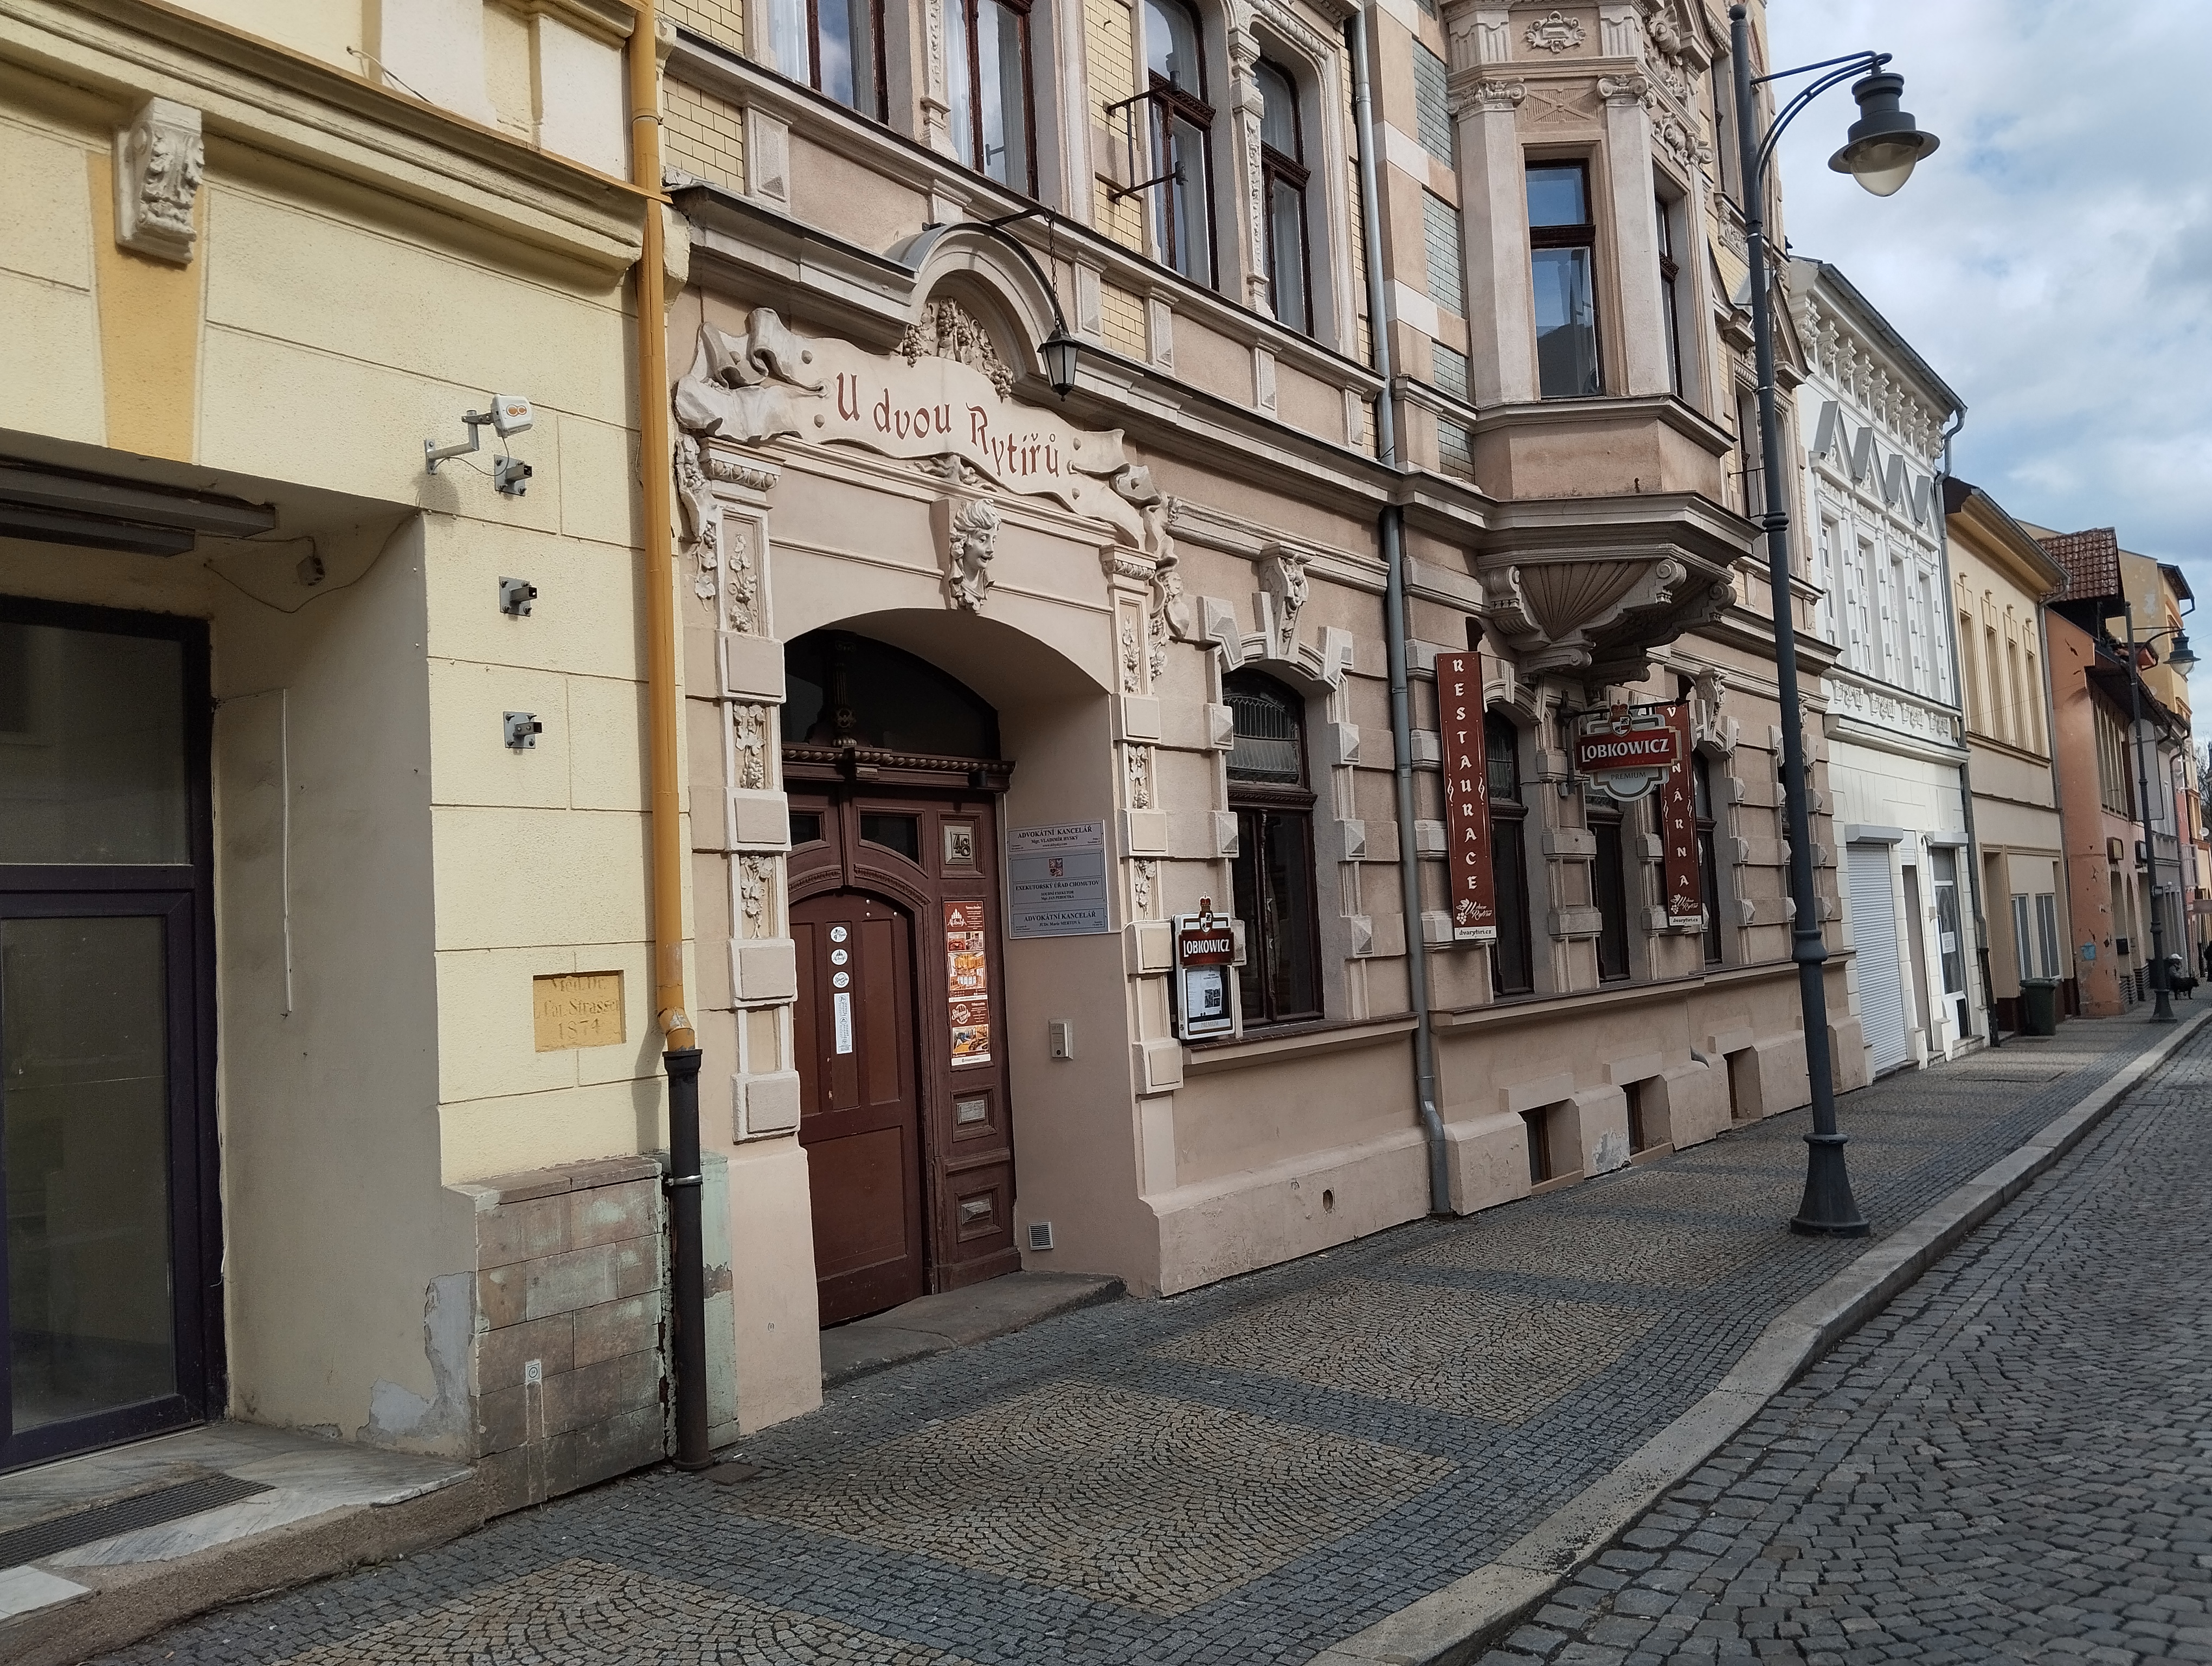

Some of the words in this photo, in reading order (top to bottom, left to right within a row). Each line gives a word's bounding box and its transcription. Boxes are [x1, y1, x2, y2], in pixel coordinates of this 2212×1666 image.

[837, 372, 860, 421] U
[873, 388, 952, 440] dvou
[965, 401, 1060, 478] Rytířů
[1581, 738, 1670, 763] LOBKOWICZ
[1452, 658, 1478, 890] RESTAURACE
[1611, 772, 1646, 780] PREMIUM
[1666, 706, 1689, 887] VNÁRNA
[1018, 828, 1054, 838] ADVOKÁTNÍ
[1057, 825, 1092, 835] KANCELÁŘ
[953, 832, 970, 857] 48
[1015, 882, 1052, 890] EXEKUTORSKÝ
[1024, 913, 1060, 921] ADVOKÁTNÍ
[1062, 910, 1096, 919] KANCELÁŘ
[1183, 939, 1230, 957] LOBKOWICZ
